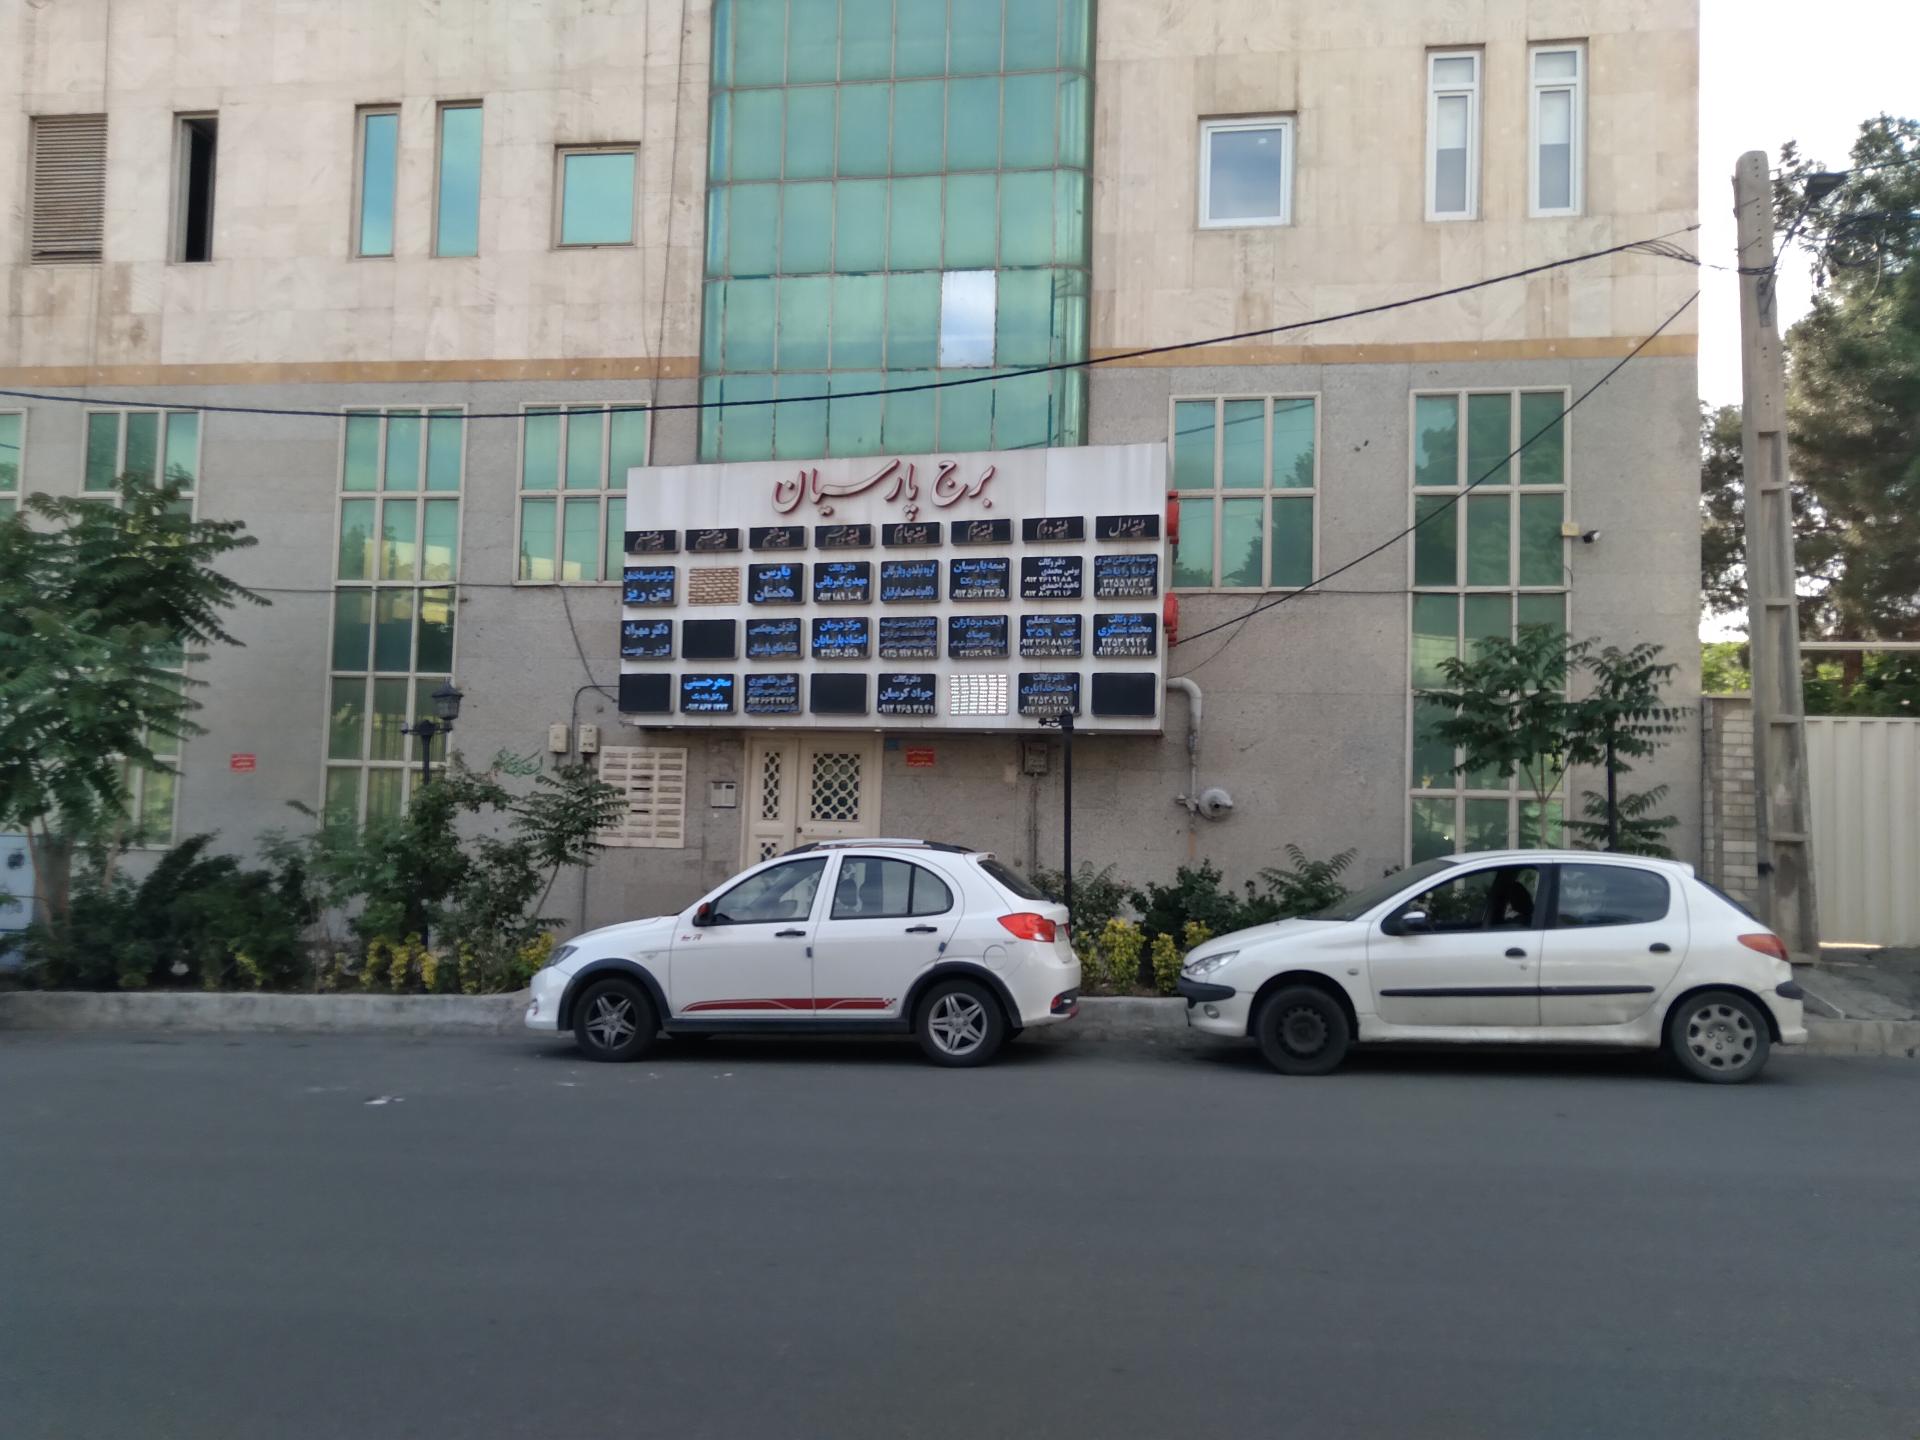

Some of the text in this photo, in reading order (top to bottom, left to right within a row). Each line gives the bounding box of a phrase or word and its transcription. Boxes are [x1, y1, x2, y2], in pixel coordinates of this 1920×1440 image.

[771, 458, 997, 522] برج پارسیان
[1108, 517, 1147, 537] طبقه اول
[759, 564, 791, 580] پارس
[953, 560, 1006, 574] بیمه پارسیان
[1041, 567, 1080, 576] یونس محمدی
[819, 620, 862, 632] مرکز درمان
[1026, 615, 1076, 626] بیمه معلم
[1060, 628, 1076, 637] کد
[1097, 625, 1153, 637] محمد عسکری
[1055, 682, 1077, 692] احمد
[910, 687, 934, 701] جواد
